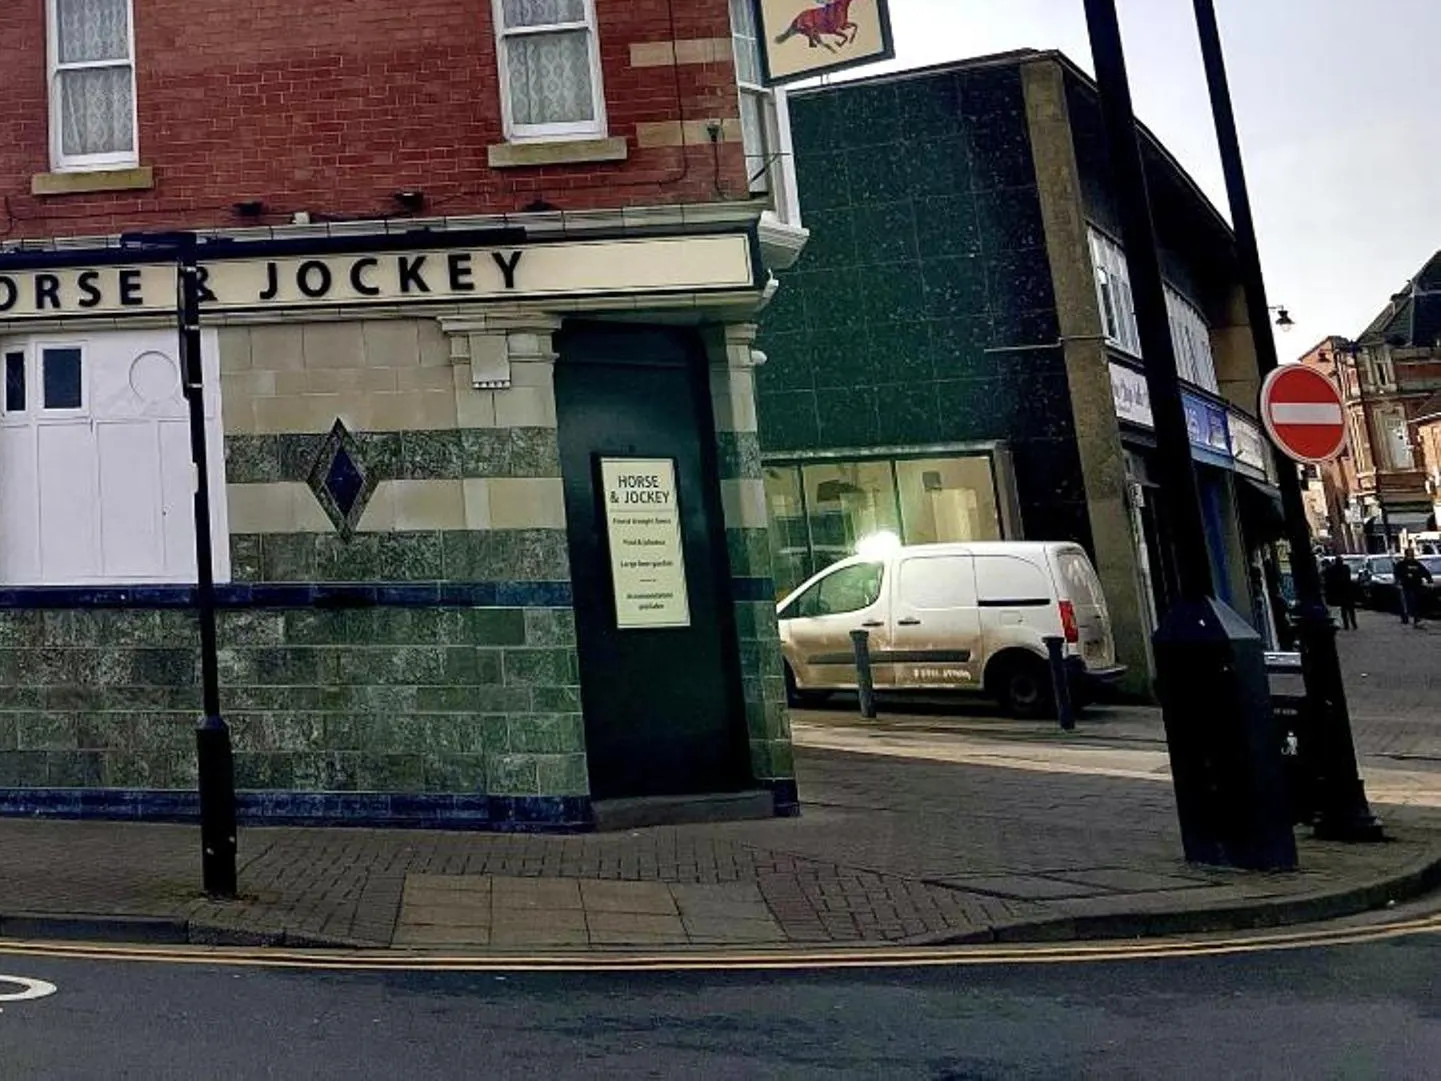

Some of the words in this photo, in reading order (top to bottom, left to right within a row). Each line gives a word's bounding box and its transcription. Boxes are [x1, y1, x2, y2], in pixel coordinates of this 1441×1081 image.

[259, 251, 523, 301] JOCKEY
[618, 475, 659, 488] HORSE
[610, 490, 620, 504] &
[624, 490, 670, 504] JOCKEY
